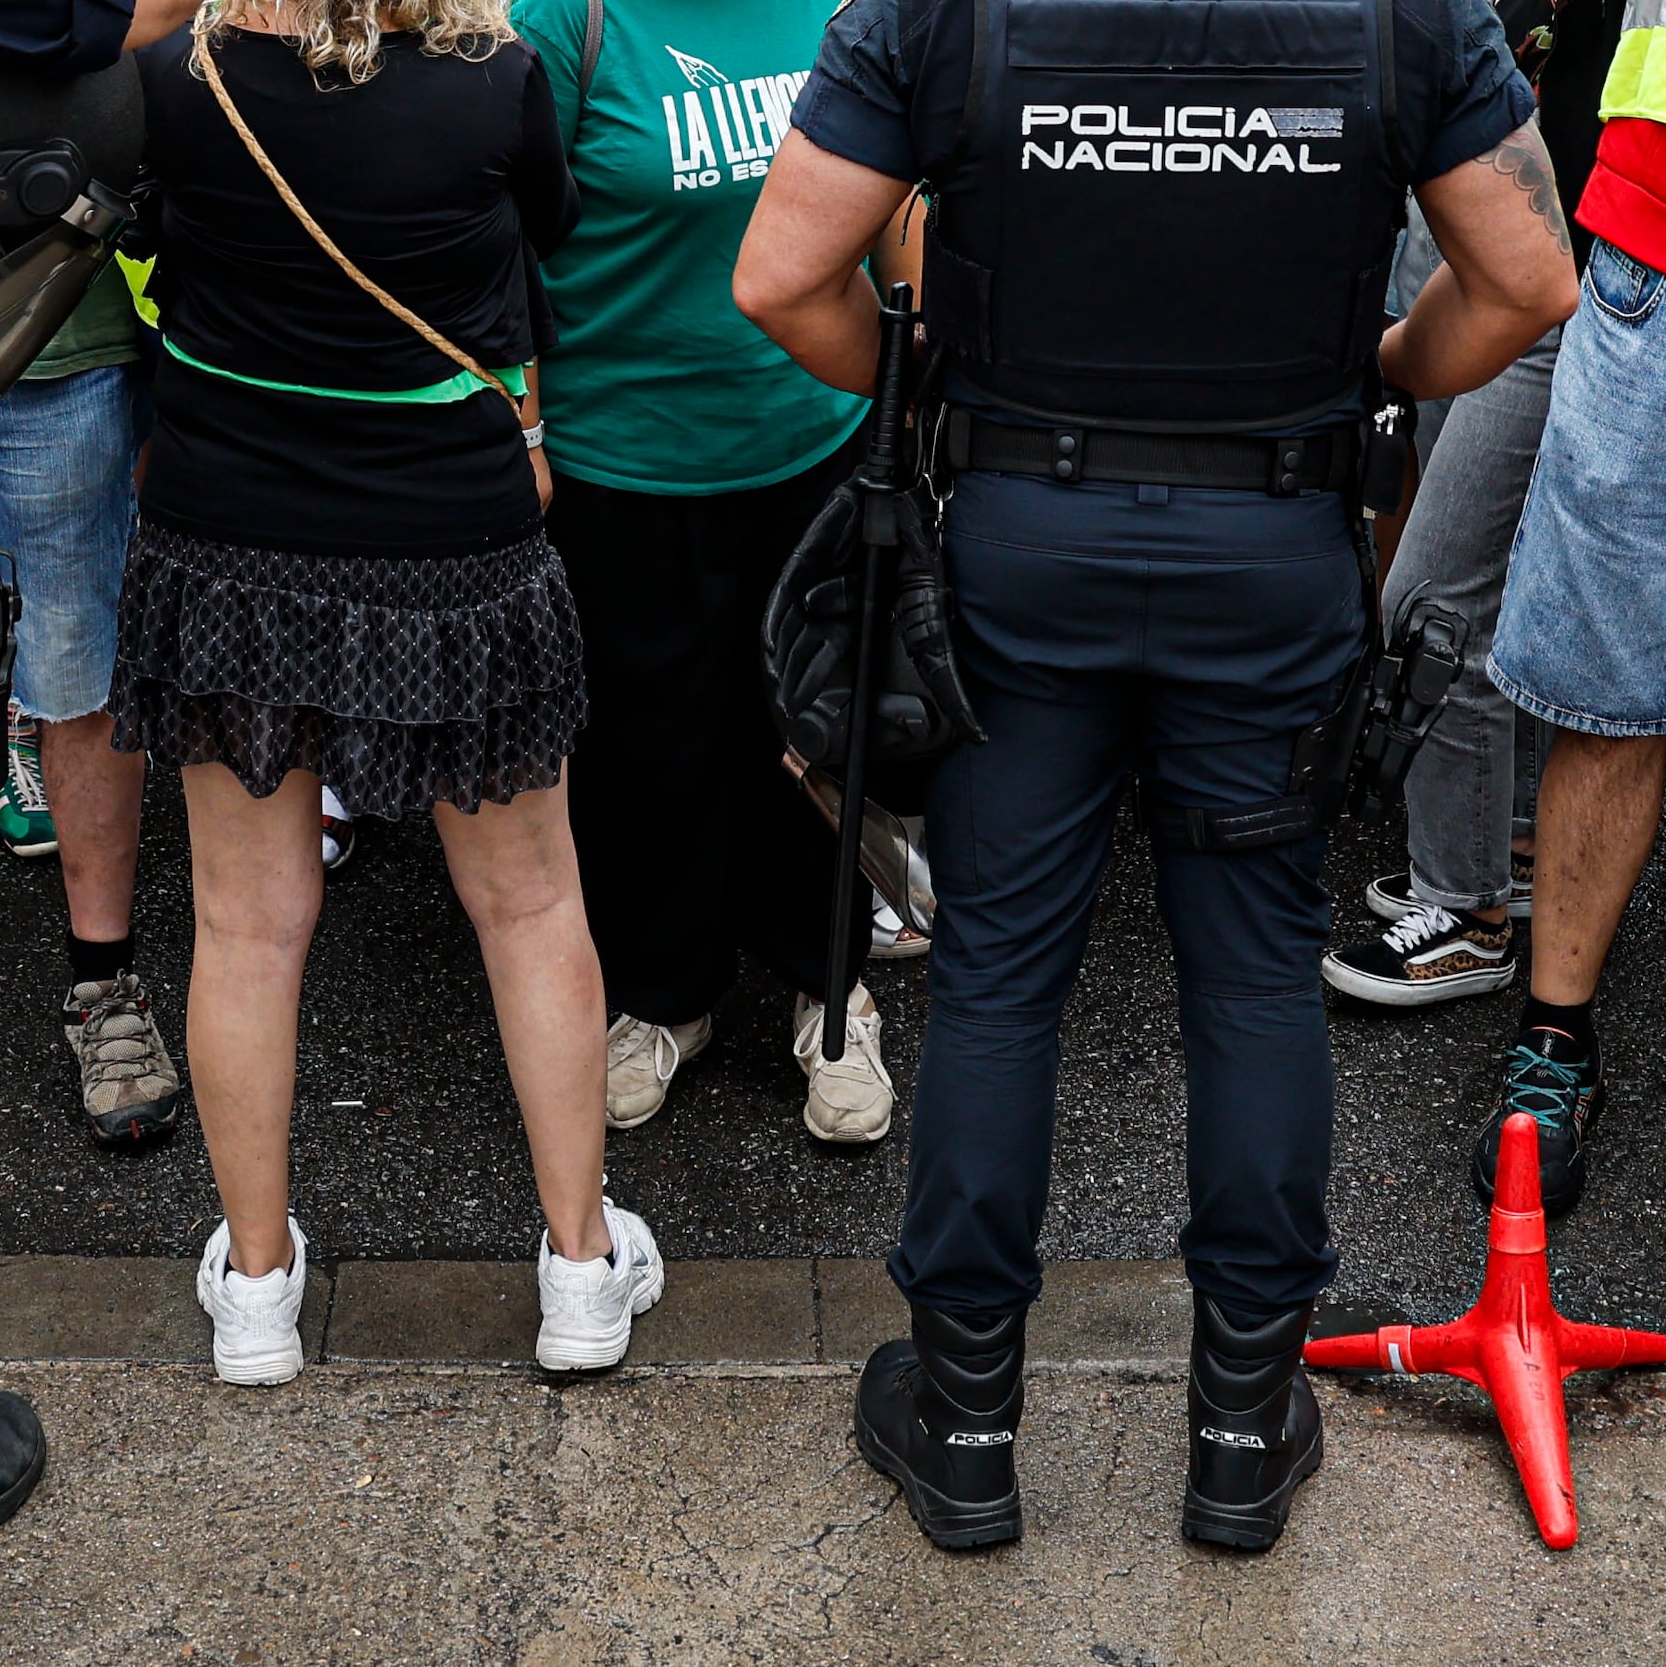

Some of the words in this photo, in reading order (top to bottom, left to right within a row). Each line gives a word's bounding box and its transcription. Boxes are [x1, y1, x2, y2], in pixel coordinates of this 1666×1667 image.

[662, 90, 718, 173] LA
[1021, 141, 1341, 173] NACIONAL
[673, 169, 721, 192] NO
[731, 159, 770, 182] ES
[954, 1431, 1010, 1446] POLICIA
[1203, 1427, 1251, 1447] POLICIA
